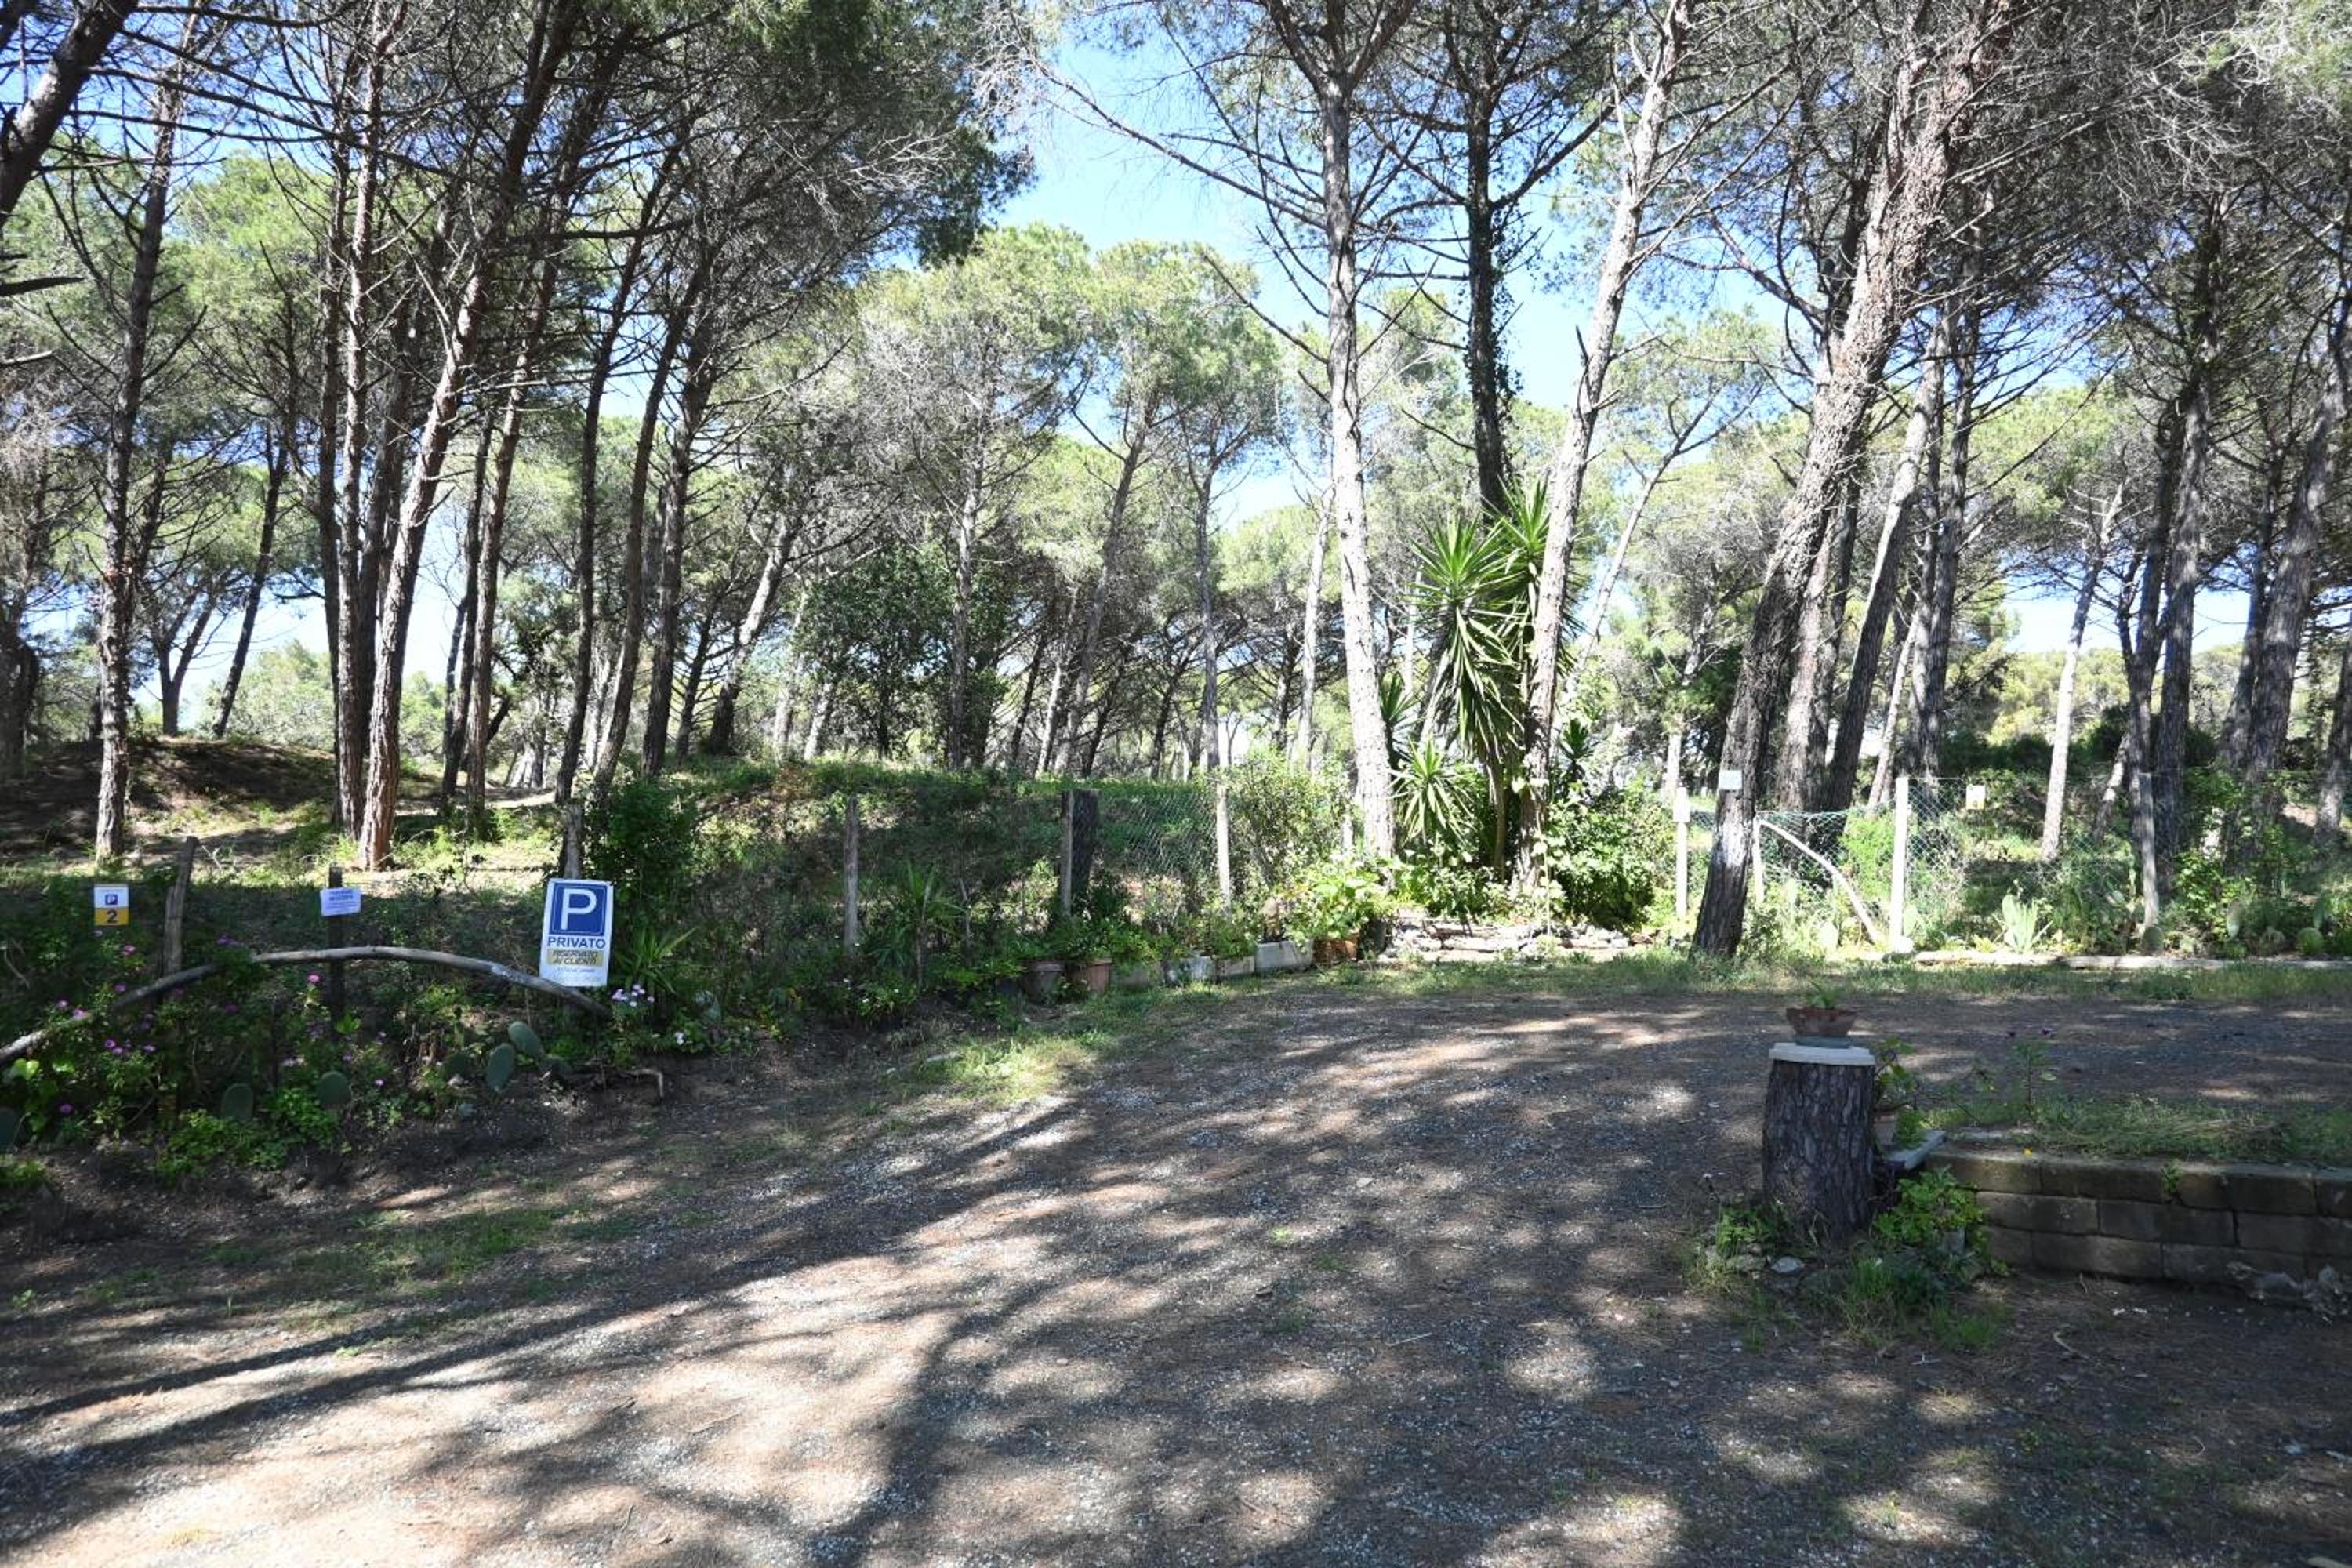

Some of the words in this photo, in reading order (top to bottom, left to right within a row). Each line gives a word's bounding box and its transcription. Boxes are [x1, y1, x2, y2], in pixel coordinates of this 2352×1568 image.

[107, 895, 116, 904] P
[107, 909, 118, 924] 2
[561, 888, 597, 931] P
[547, 936, 606, 949] PRIVATO
